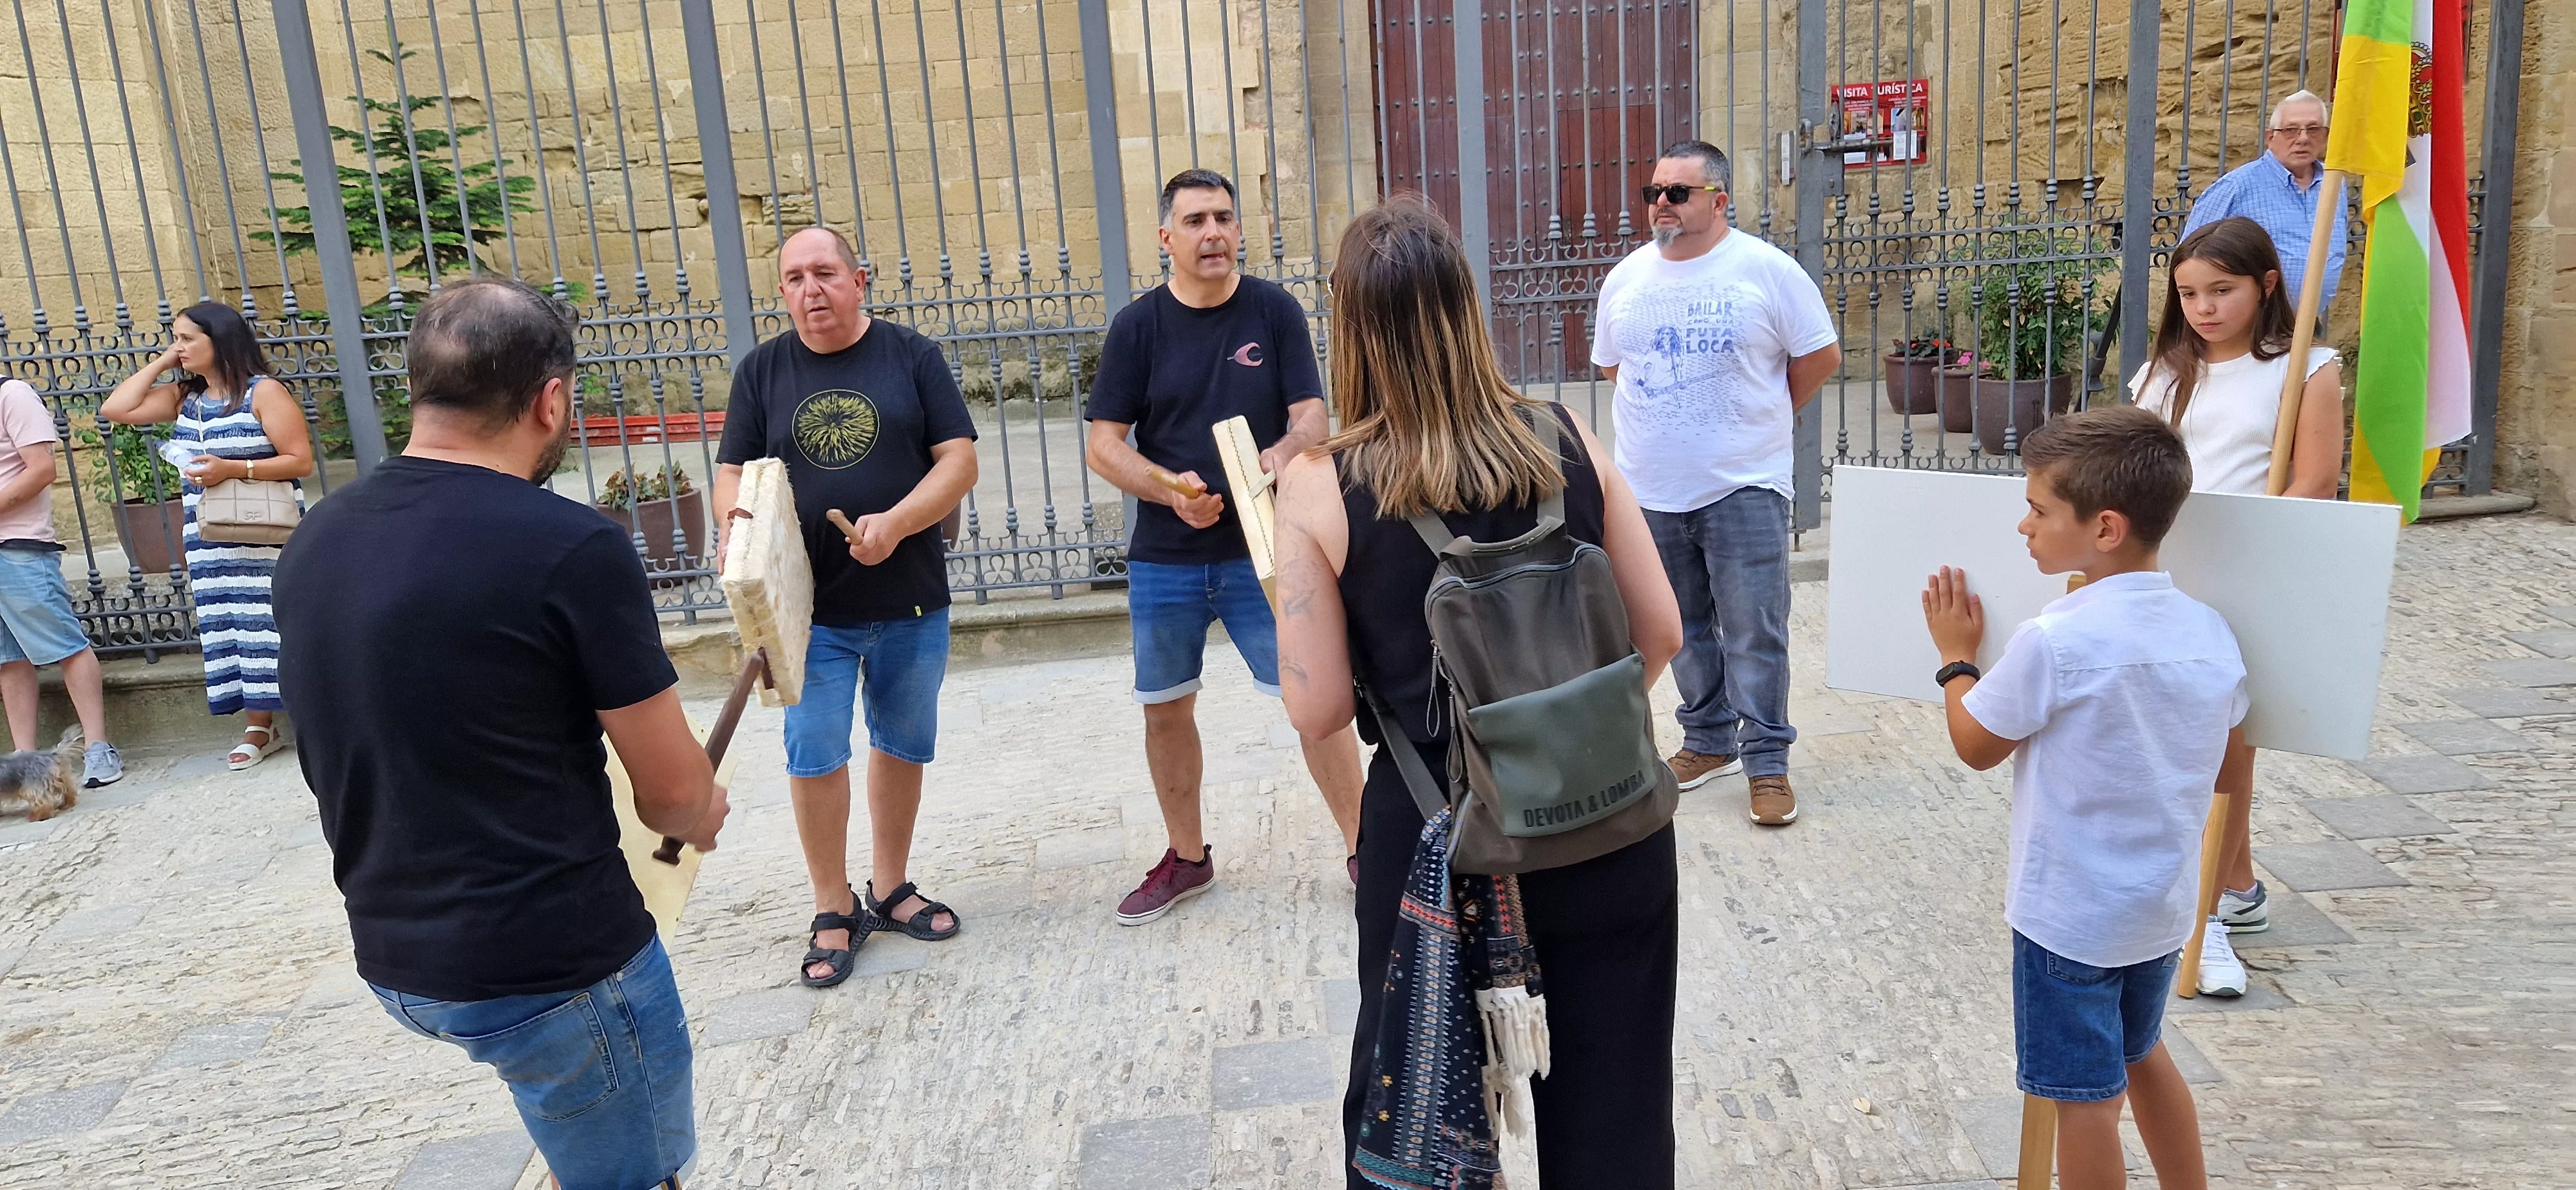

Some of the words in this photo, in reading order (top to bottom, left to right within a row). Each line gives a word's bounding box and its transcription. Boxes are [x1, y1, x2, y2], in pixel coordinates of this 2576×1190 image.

[1871, 82, 1923, 95] URÍSTCA
[1687, 301, 1733, 317] BAILAR
[1686, 327, 1733, 338] PUTA
[1686, 339, 1735, 354] LOCA
[1523, 800, 1586, 827] DEVOTA
[1587, 795, 1599, 813] &
[1600, 770, 1647, 808] LOMBA
